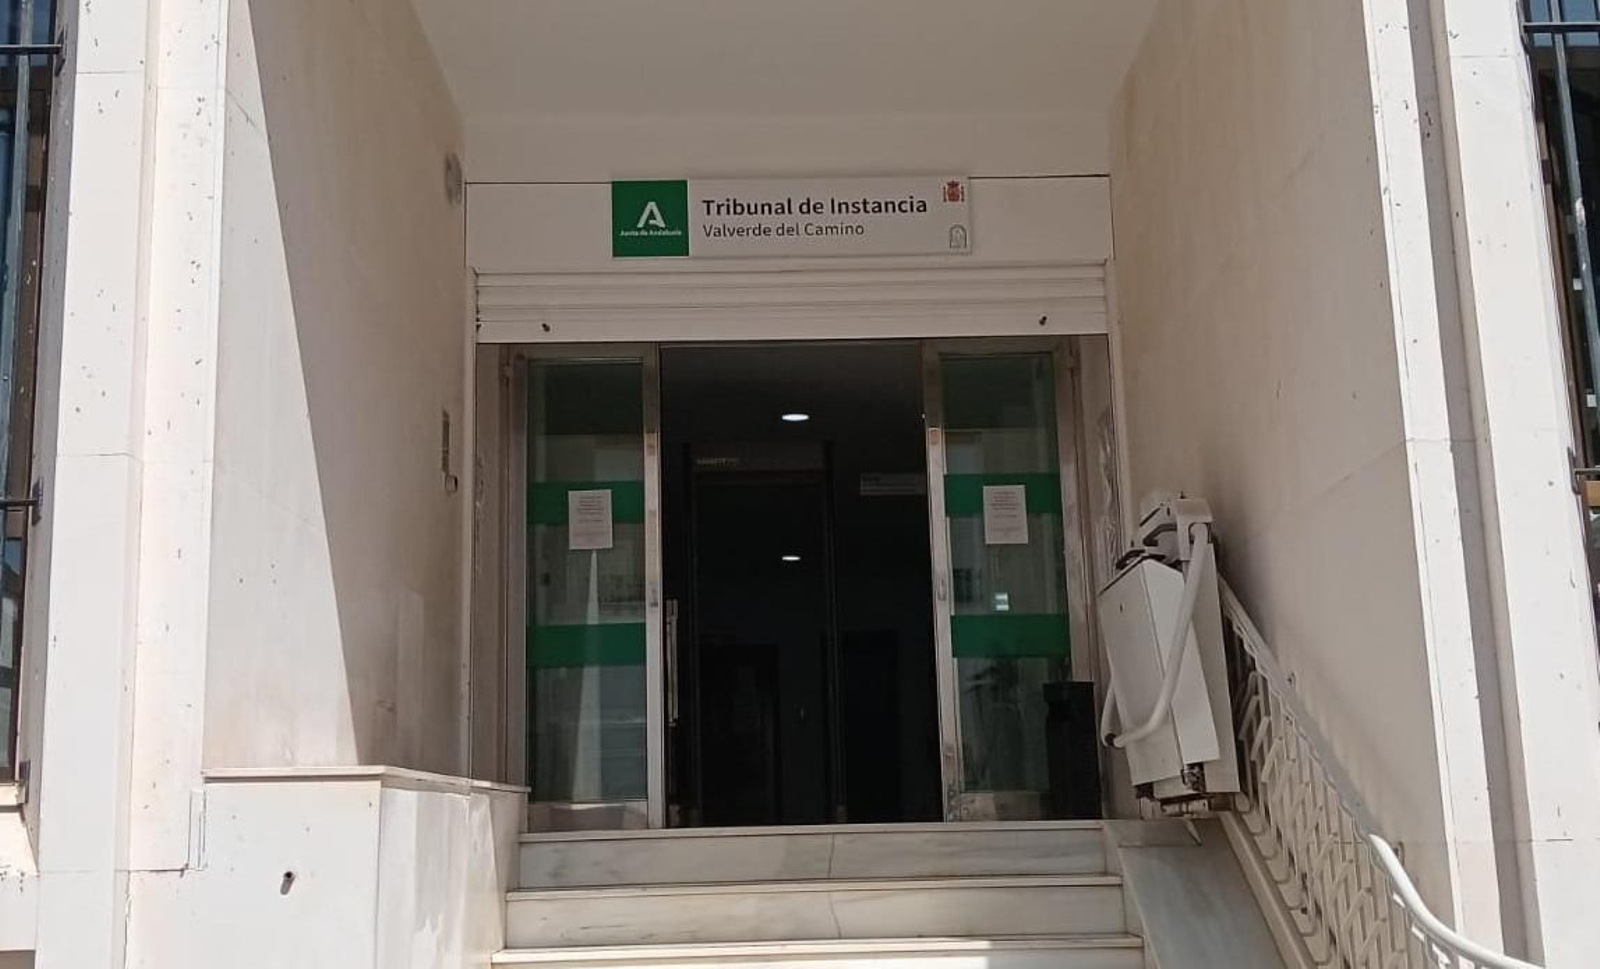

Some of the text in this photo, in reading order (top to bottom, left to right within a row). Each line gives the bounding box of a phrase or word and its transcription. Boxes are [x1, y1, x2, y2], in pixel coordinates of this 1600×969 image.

[702, 195, 927, 216] Tribunal de Instancia
[703, 222, 865, 237] Valverde del Camino
